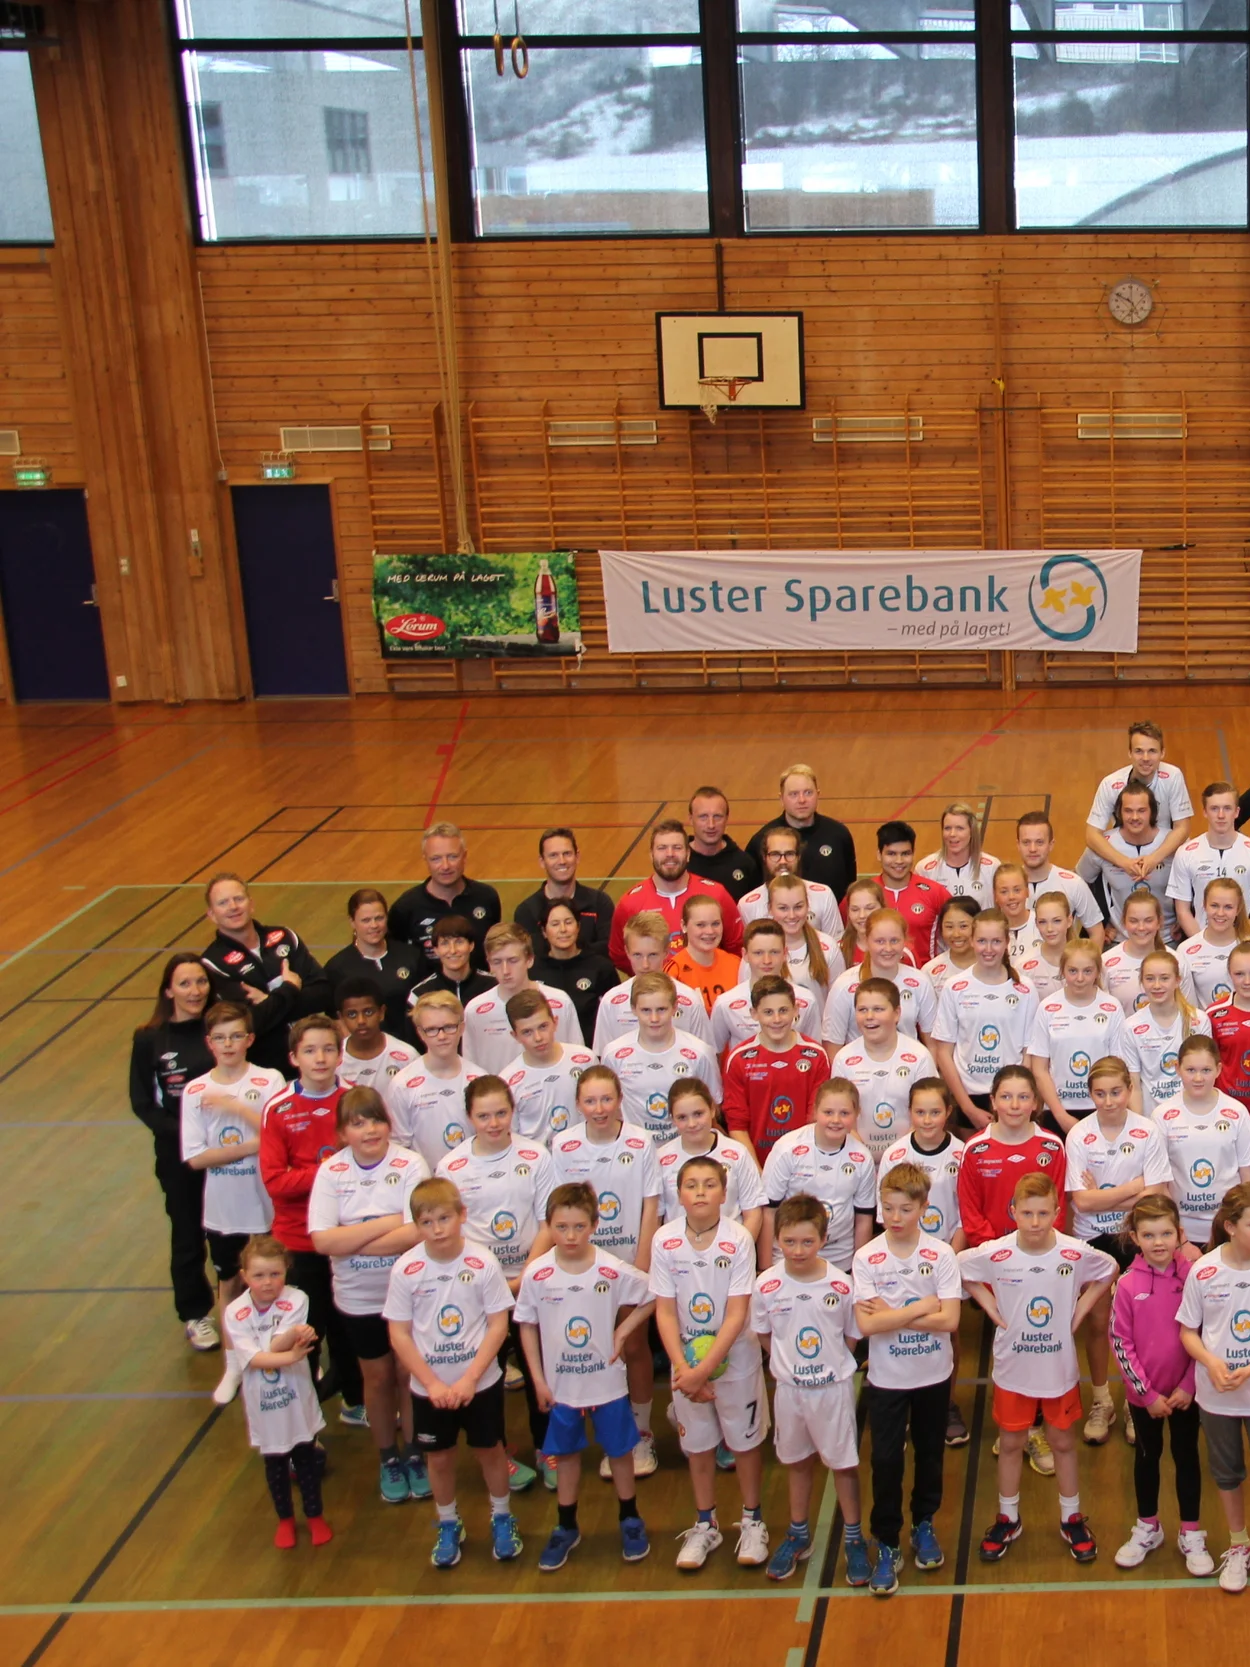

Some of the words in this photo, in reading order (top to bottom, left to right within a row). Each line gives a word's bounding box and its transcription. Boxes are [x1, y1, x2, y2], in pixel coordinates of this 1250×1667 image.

[387, 574, 410, 583] MED
[453, 571, 466, 582] PÅ
[471, 573, 505, 582] LAGET
[642, 579, 766, 614] Luster
[785, 574, 1009, 622] Sparebank
[901, 621, 937, 636] med
[940, 620, 960, 639] på
[964, 621, 1012, 639] laget!
[1216, 867, 1227, 878] 14
[954, 885, 965, 896] 30
[1011, 945, 1025, 956] 29
[974, 1055, 1000, 1063] Luster
[967, 1063, 1000, 1074] Spareba
[1187, 1192, 1216, 1201] Luster
[1097, 1212, 1126, 1223] Luster
[588, 1235, 636, 1247] parebank
[350, 1256, 399, 1270] Spareba
[899, 1333, 930, 1344] Luster
[1022, 1332, 1053, 1342] Luster
[434, 1341, 465, 1353] Luster
[889, 1340, 942, 1357] Sparebank
[1012, 1340, 1063, 1354] Sparebank
[561, 1353, 593, 1362] Luster
[556, 1360, 606, 1375] Sparebank
[793, 1364, 825, 1375] Luster
[745, 1400, 758, 1428] 7
